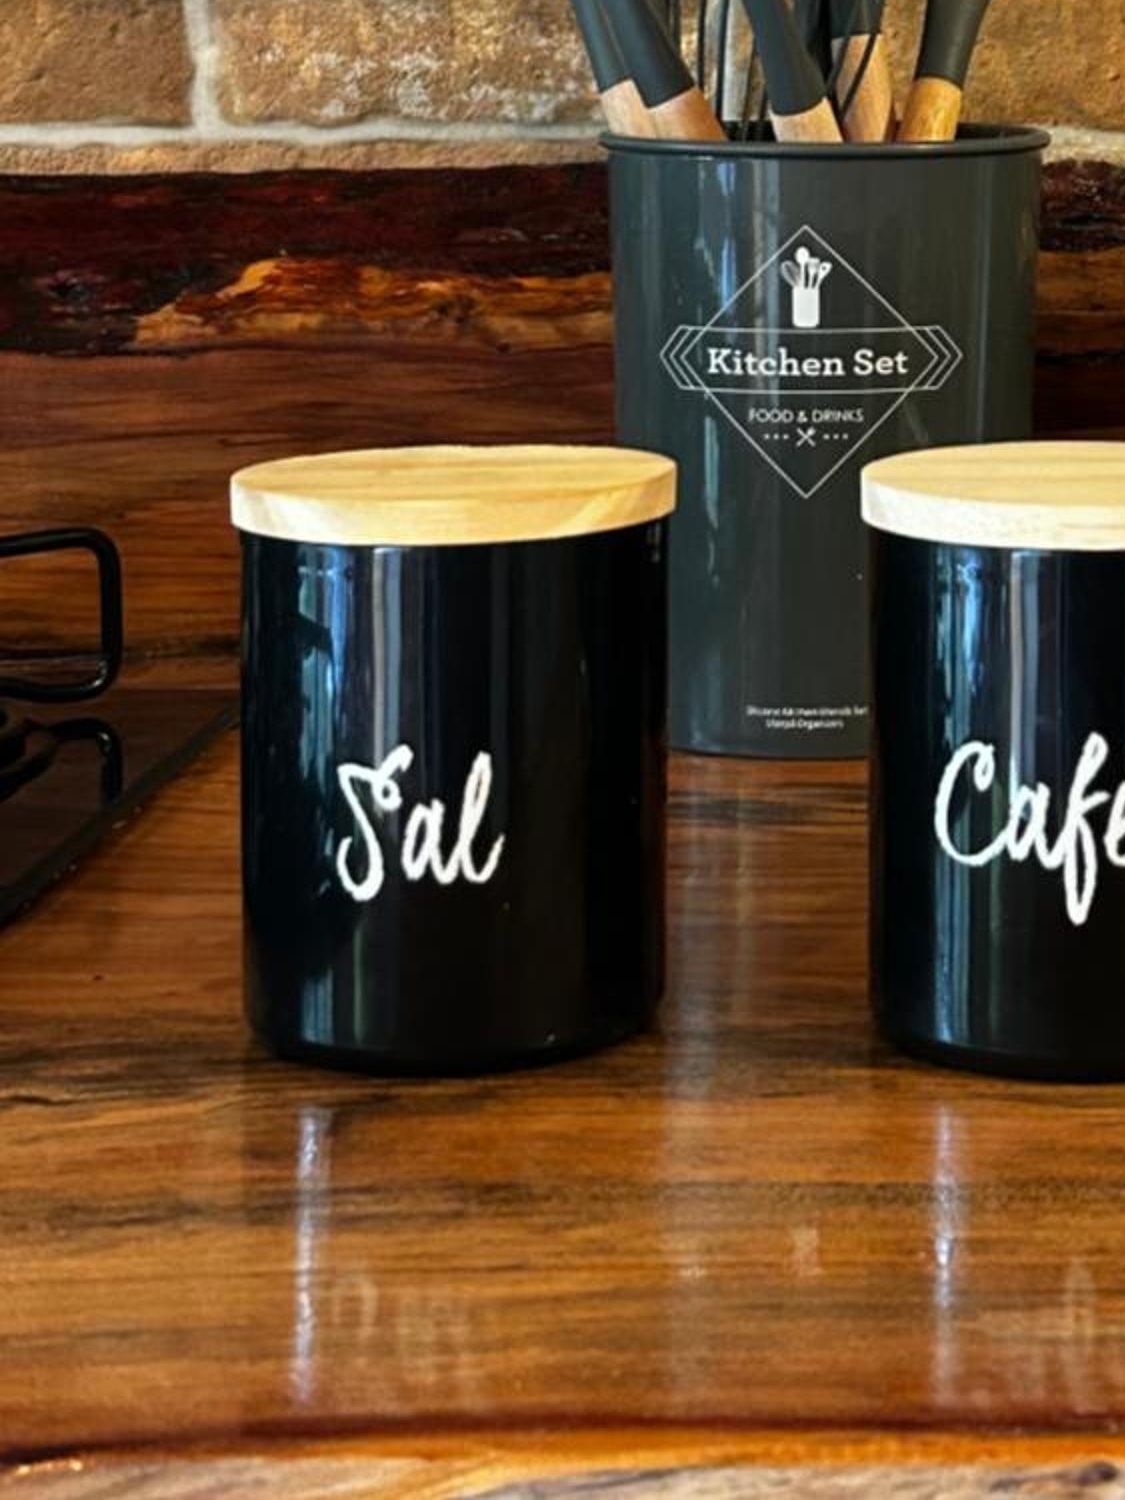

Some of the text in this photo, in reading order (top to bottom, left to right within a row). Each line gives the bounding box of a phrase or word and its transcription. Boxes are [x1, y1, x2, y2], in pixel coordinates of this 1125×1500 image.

[707, 346, 908, 377] Kitchen Set
[748, 407, 865, 422] FOOD & DRINKS
[335, 740, 505, 902] Sal
